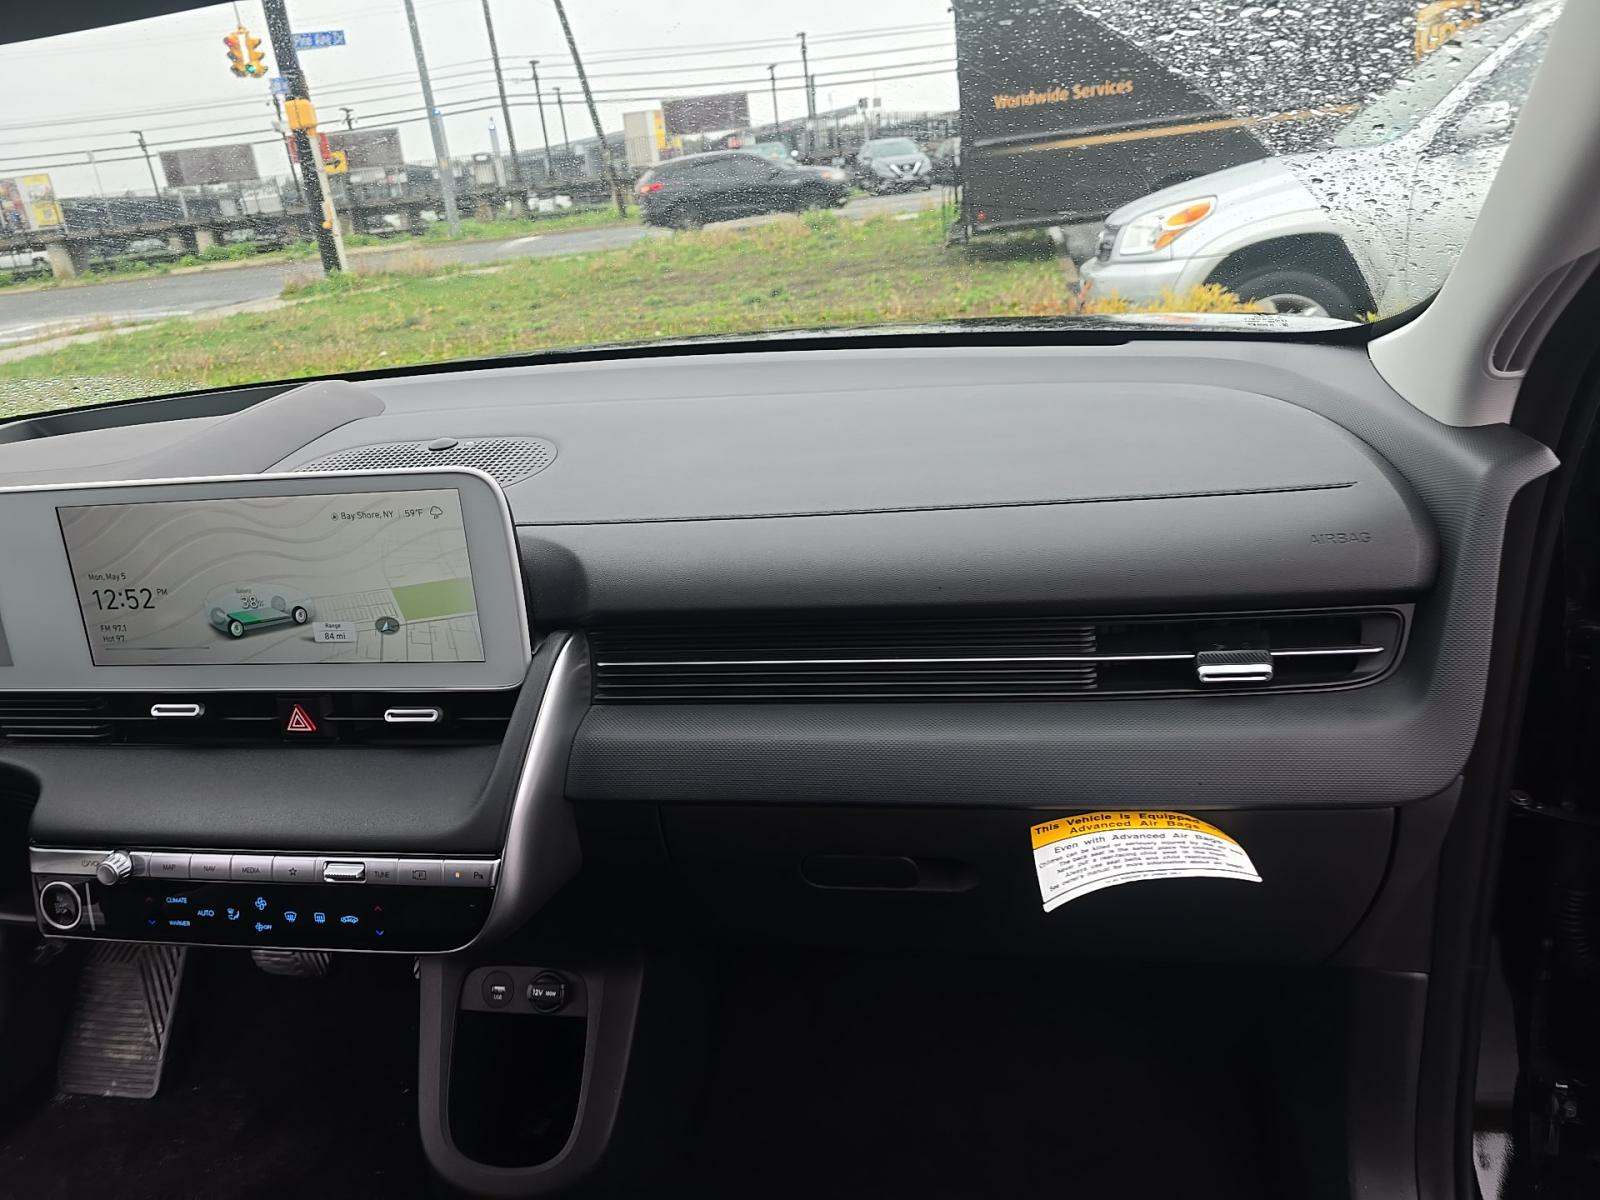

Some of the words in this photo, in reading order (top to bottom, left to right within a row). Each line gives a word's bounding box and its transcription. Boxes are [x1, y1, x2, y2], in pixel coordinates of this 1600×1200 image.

[1072, 80, 1134, 100] Services
[340, 512, 355, 521] Bay
[356, 510, 382, 519] Shore,
[383, 510, 393, 518] NY
[1310, 531, 1371, 544] AIRBAG
[105, 573, 119, 582] May
[120, 572, 126, 580] 5
[92, 588, 156, 610] 12:52
[156, 588, 168, 596] PM
[100, 624, 110, 632] FM
[324, 632, 335, 640] 84
[336, 632, 346, 640] mi
[1035, 823, 1060, 835] This
[1066, 813, 1112, 826] Vehicle
[1069, 821, 1131, 835] Advanced
[1167, 820, 1201, 829] Bags
[1054, 842, 1079, 854] Even
[1084, 837, 1106, 846] with
[1112, 832, 1166, 841] Advanced
[162, 864, 176, 872] MAP
[203, 865, 216, 873] NAV
[242, 866, 260, 874] MEDIA
[165, 896, 188, 905] CLIMATE
[197, 909, 215, 918] AUTO
[532, 987, 544, 997] 12V
